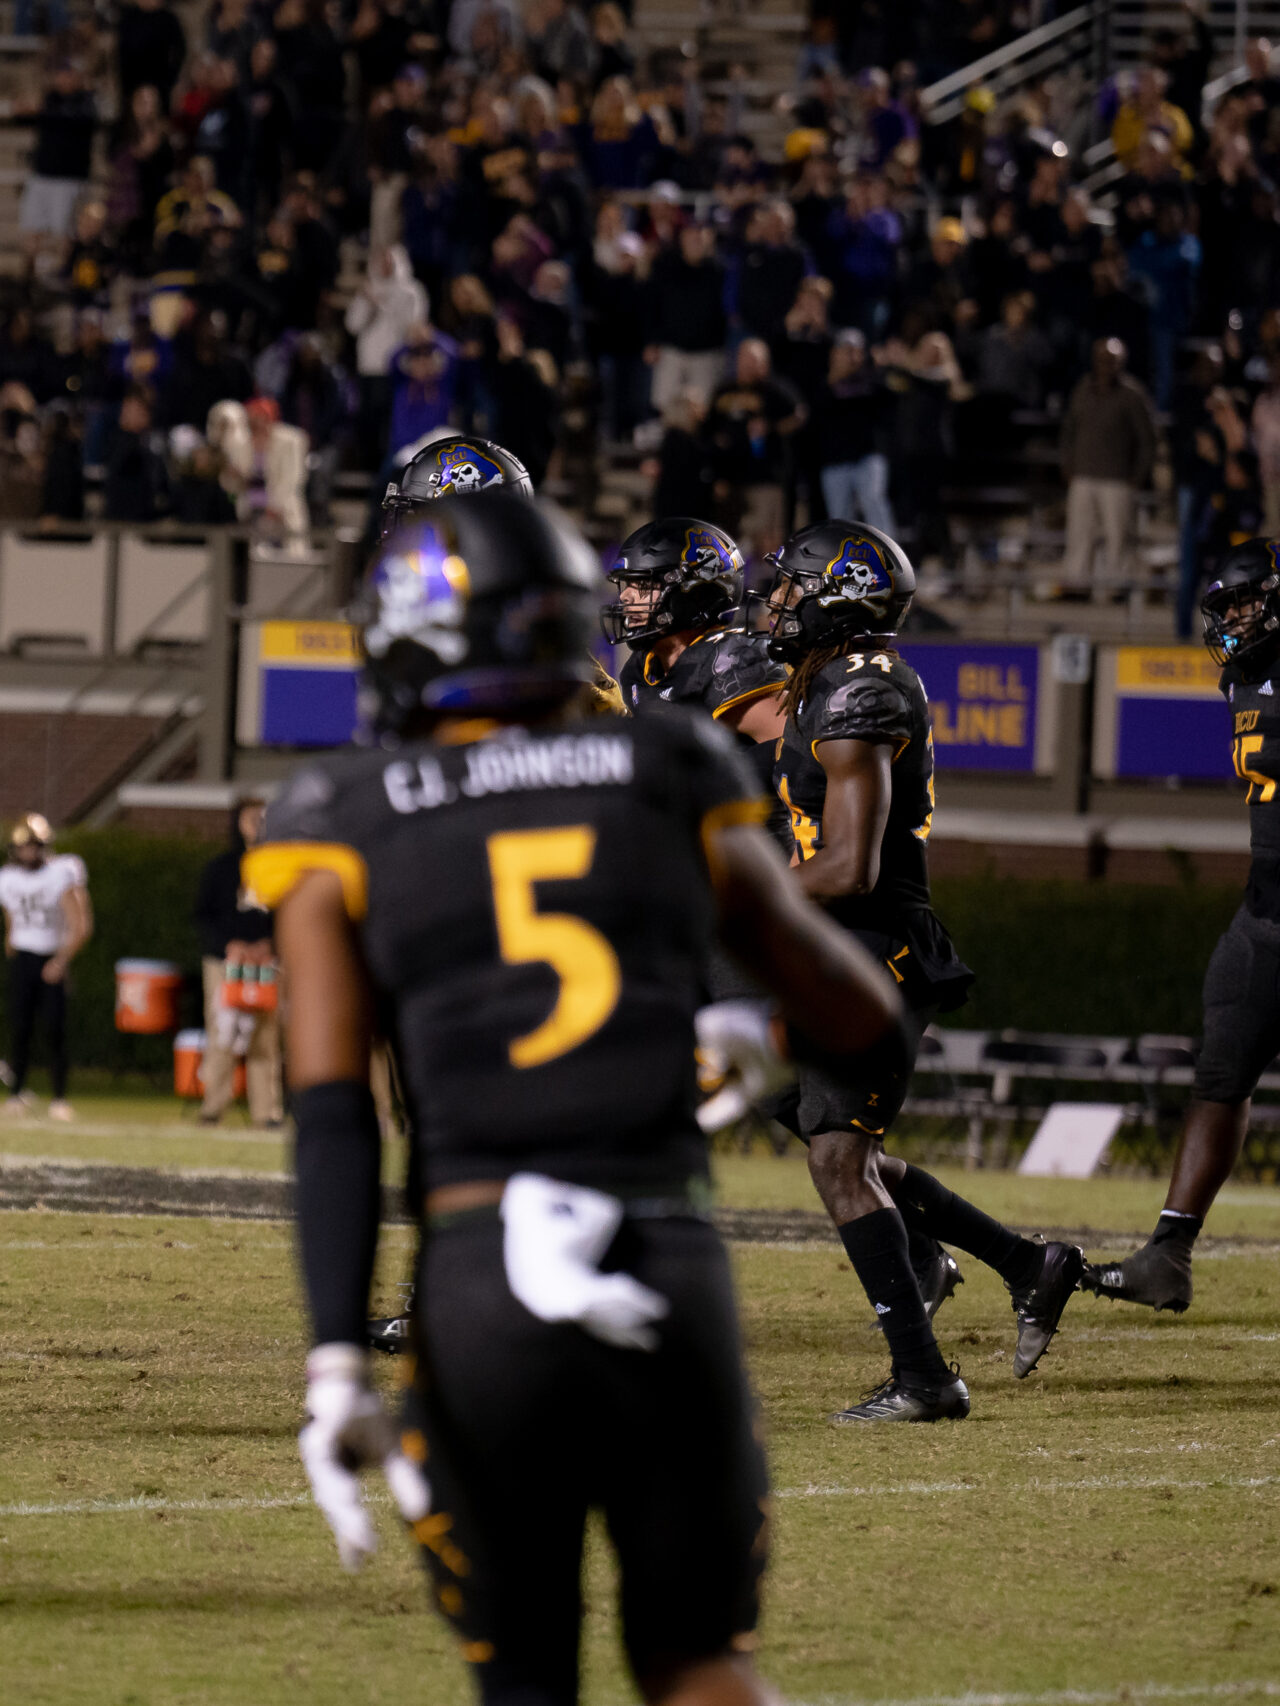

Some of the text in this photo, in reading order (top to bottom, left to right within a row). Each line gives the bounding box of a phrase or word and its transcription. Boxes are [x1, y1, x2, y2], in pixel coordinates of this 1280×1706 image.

[445, 450, 467, 465] ECU
[847, 547, 872, 559] ECU
[846, 653, 893, 673] 34
[957, 663, 1026, 700] BILL
[461, 733, 635, 797] JOHNSON
[486, 823, 623, 1070] 5
